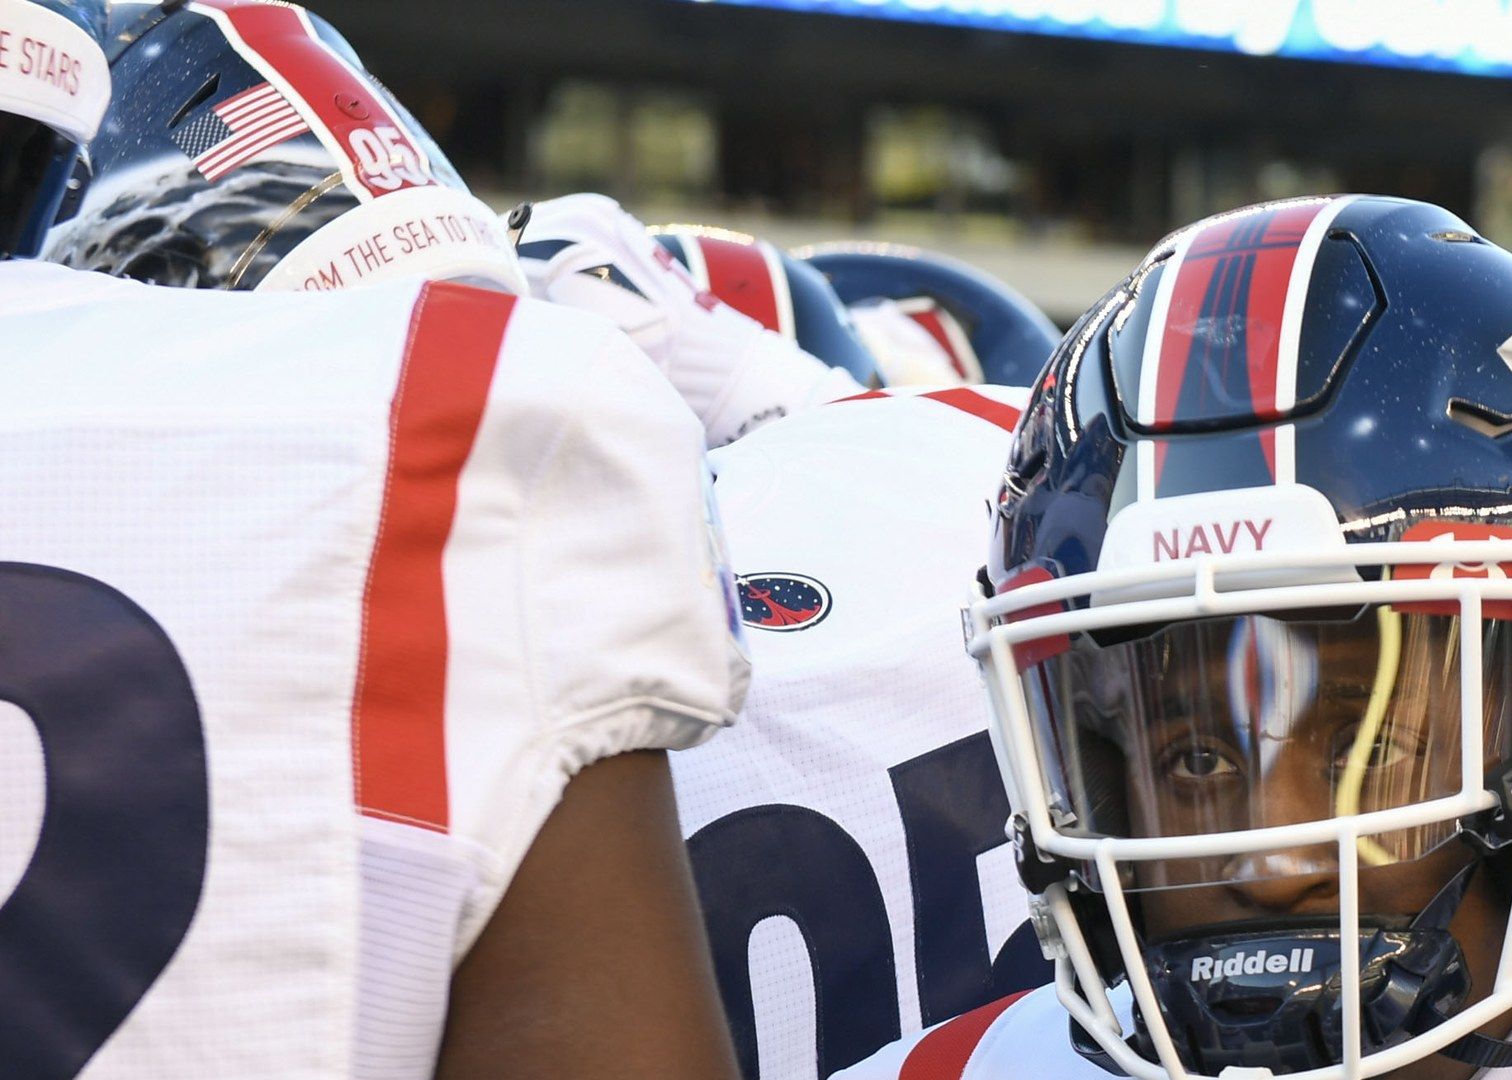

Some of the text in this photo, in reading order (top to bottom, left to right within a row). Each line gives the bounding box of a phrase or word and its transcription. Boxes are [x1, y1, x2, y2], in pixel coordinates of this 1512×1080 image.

[20, 37, 81, 96] STARS
[349, 126, 429, 190] 95
[344, 234, 394, 278] THE
[393, 219, 439, 254] SEA
[436, 215, 467, 242] TO
[1153, 518, 1273, 562] NAVY
[1191, 948, 1314, 982] Riddell
